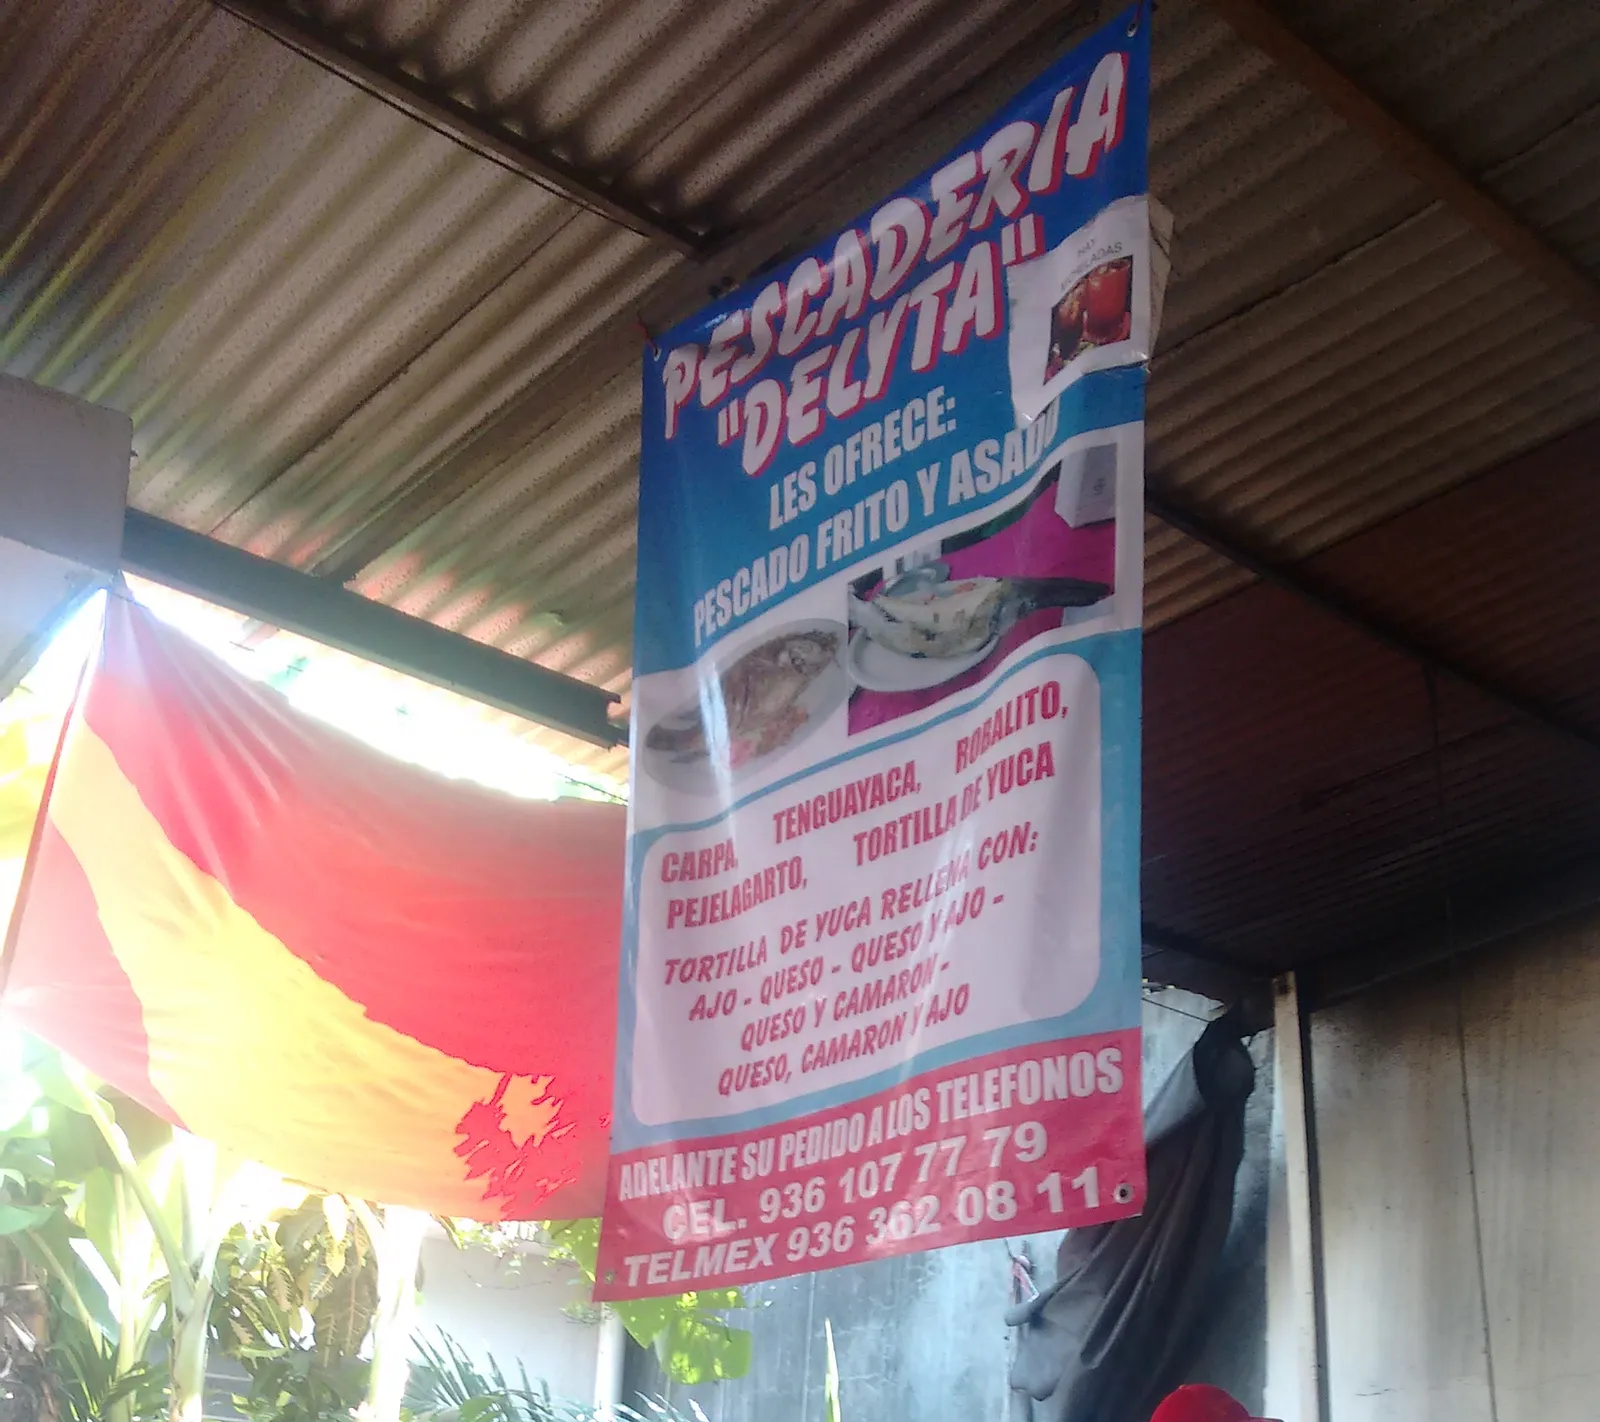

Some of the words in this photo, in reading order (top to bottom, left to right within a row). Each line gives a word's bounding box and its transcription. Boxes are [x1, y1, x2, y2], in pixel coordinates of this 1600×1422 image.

[663, 52, 1129, 440] PESCADERIA
[770, 461, 818, 531] LES
[824, 386, 957, 496] OFRECE:
[693, 533, 810, 648] PESCADO
[816, 479, 910, 571] FRITO
[916, 462, 941, 518] Y
[667, 855, 808, 930] PEJELAGARTO,
[853, 795, 958, 867] TORTILLA
[960, 775, 982, 822] DE
[987, 741, 1056, 801] YUCA
[773, 760, 922, 844] TENGUAYACA,
[955, 680, 1068, 775] ROBALITO,
[664, 935, 768, 985] TORTILLA
[780, 918, 808, 955] DE
[816, 896, 871, 942] YUCA
[881, 850, 971, 920] RELLENA
[978, 821, 1039, 870] CON:
[688, 988, 738, 1021] AJO
[760, 956, 824, 1005] QUESO
[852, 921, 923, 974] QUESO
[928, 909, 943, 943] Y
[944, 886, 986, 934] AJO
[718, 1053, 792, 1096] QUESO,
[802, 1011, 908, 1074] CAMARON
[911, 1003, 924, 1036] Y
[925, 983, 970, 1037] AJO
[741, 1005, 807, 1052] QUESO
[814, 997, 828, 1028] Y
[833, 953, 938, 1022] CAMARON
[619, 1147, 738, 1202] ADELANTE
[742, 1138, 776, 1181] SU
[778, 1112, 865, 1172] PEDIDO
[867, 1105, 884, 1148] A
[886, 1087, 931, 1141] LOS
[936, 1047, 1124, 1124] TELEFONOS
[662, 1198, 748, 1241] CEL.
[759, 1176, 826, 1224] 936
[838, 1152, 903, 1205] 107
[913, 1135, 967, 1184] 77
[982, 1121, 1047, 1168] 79
[623, 1233, 780, 1288] TELMEX
[785, 1215, 856, 1263] 936
[865, 1194, 942, 1246] 362
[955, 1180, 1018, 1227] 08
[1036, 1165, 1100, 1214] 11
